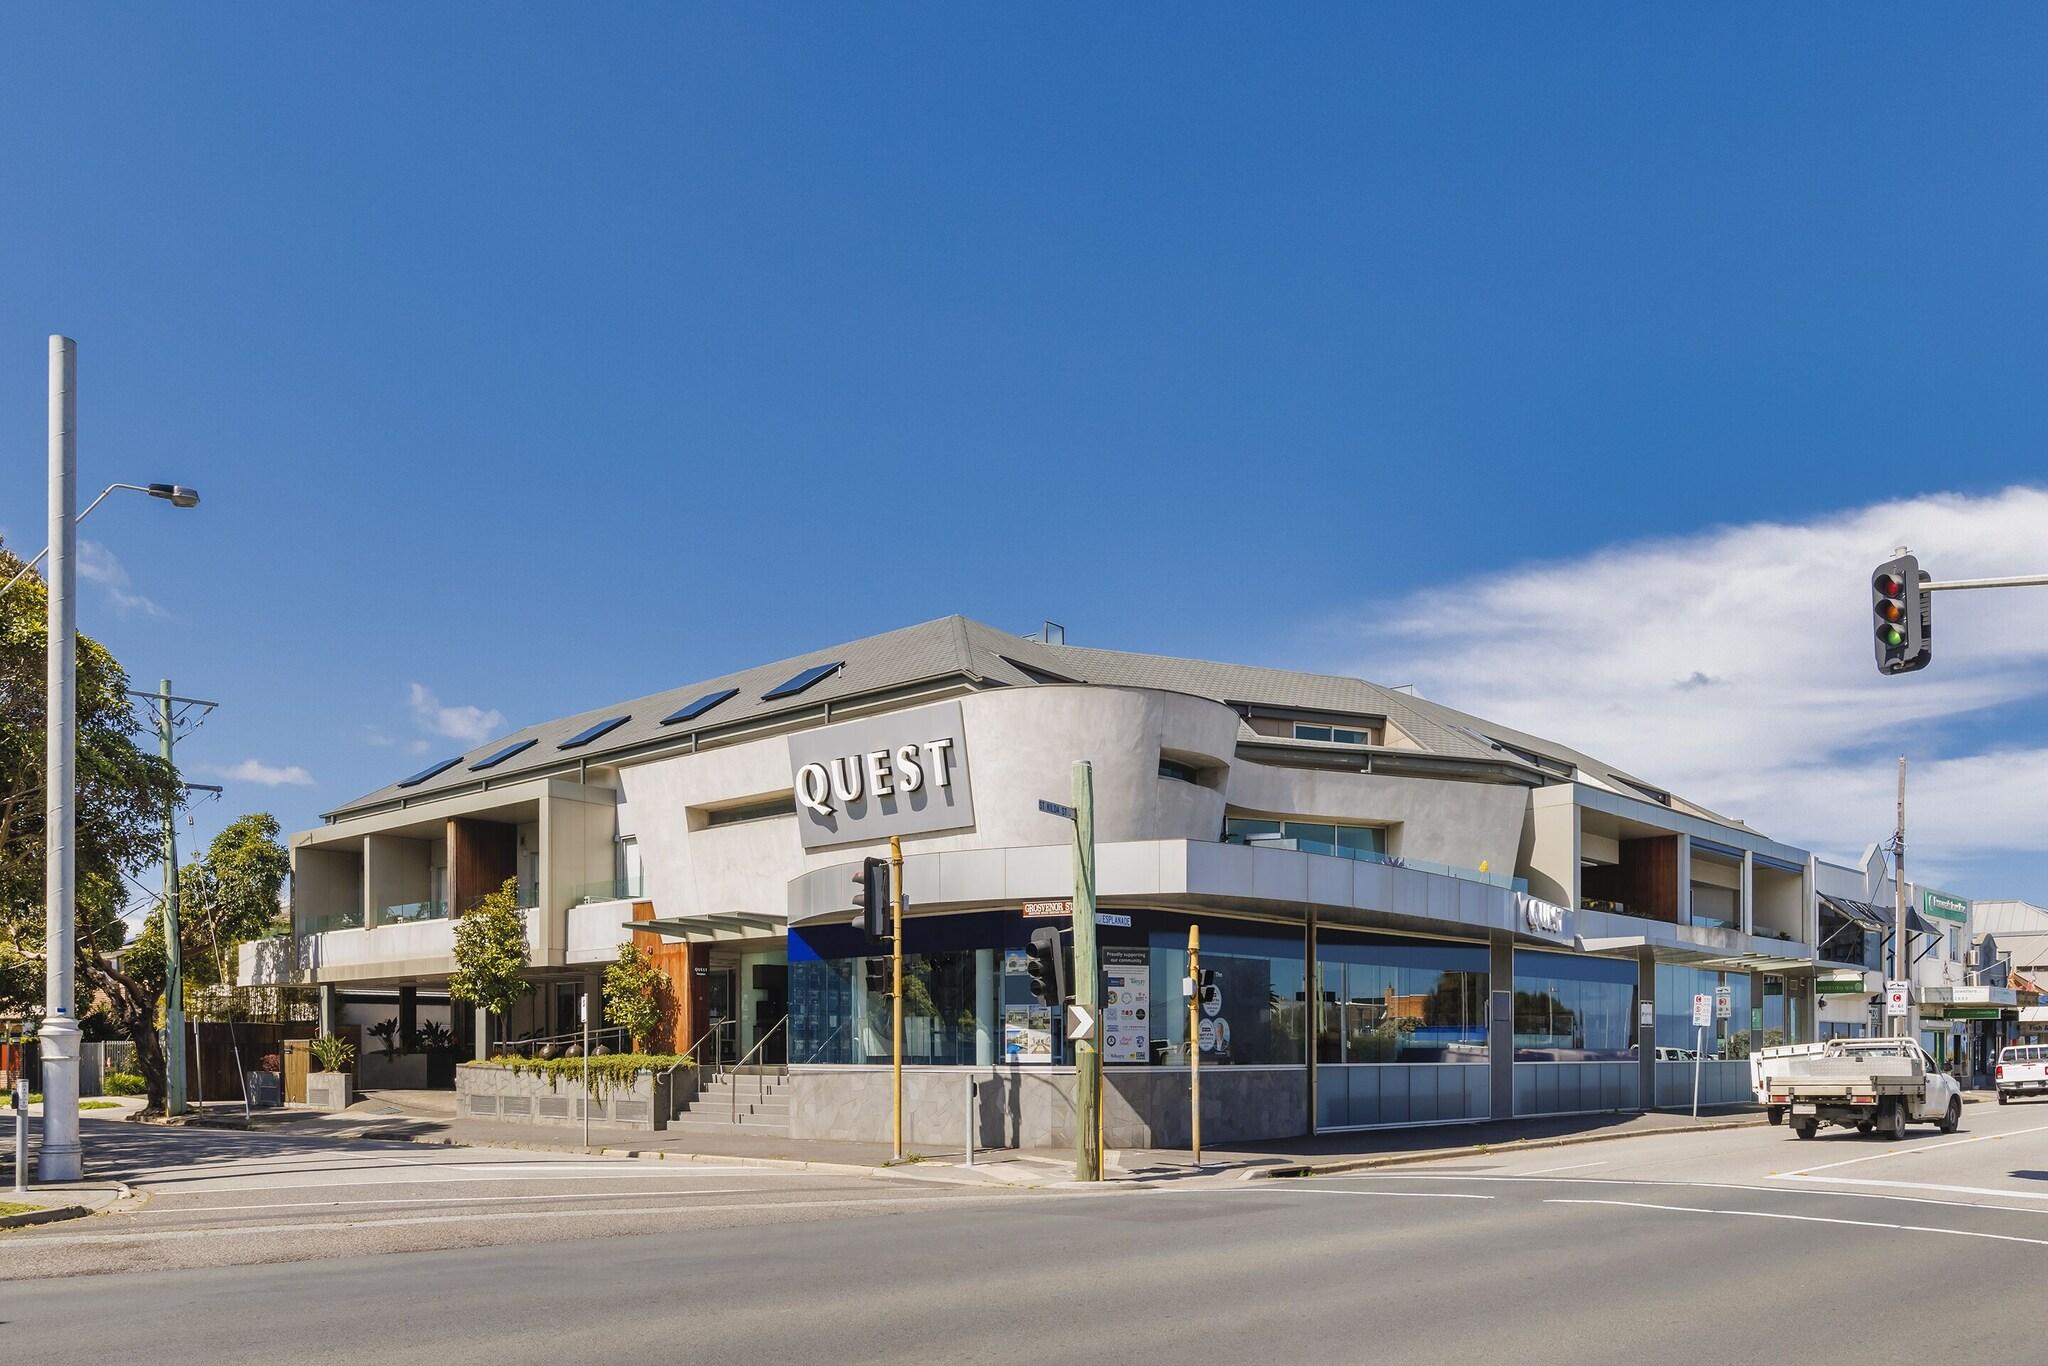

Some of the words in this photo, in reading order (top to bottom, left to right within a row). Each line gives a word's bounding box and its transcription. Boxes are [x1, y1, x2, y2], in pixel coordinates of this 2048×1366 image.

[796, 738, 954, 816] QUEST
[1025, 902, 1064, 912] GROSVENOR
[1103, 915, 1130, 926] ESPLANADE
